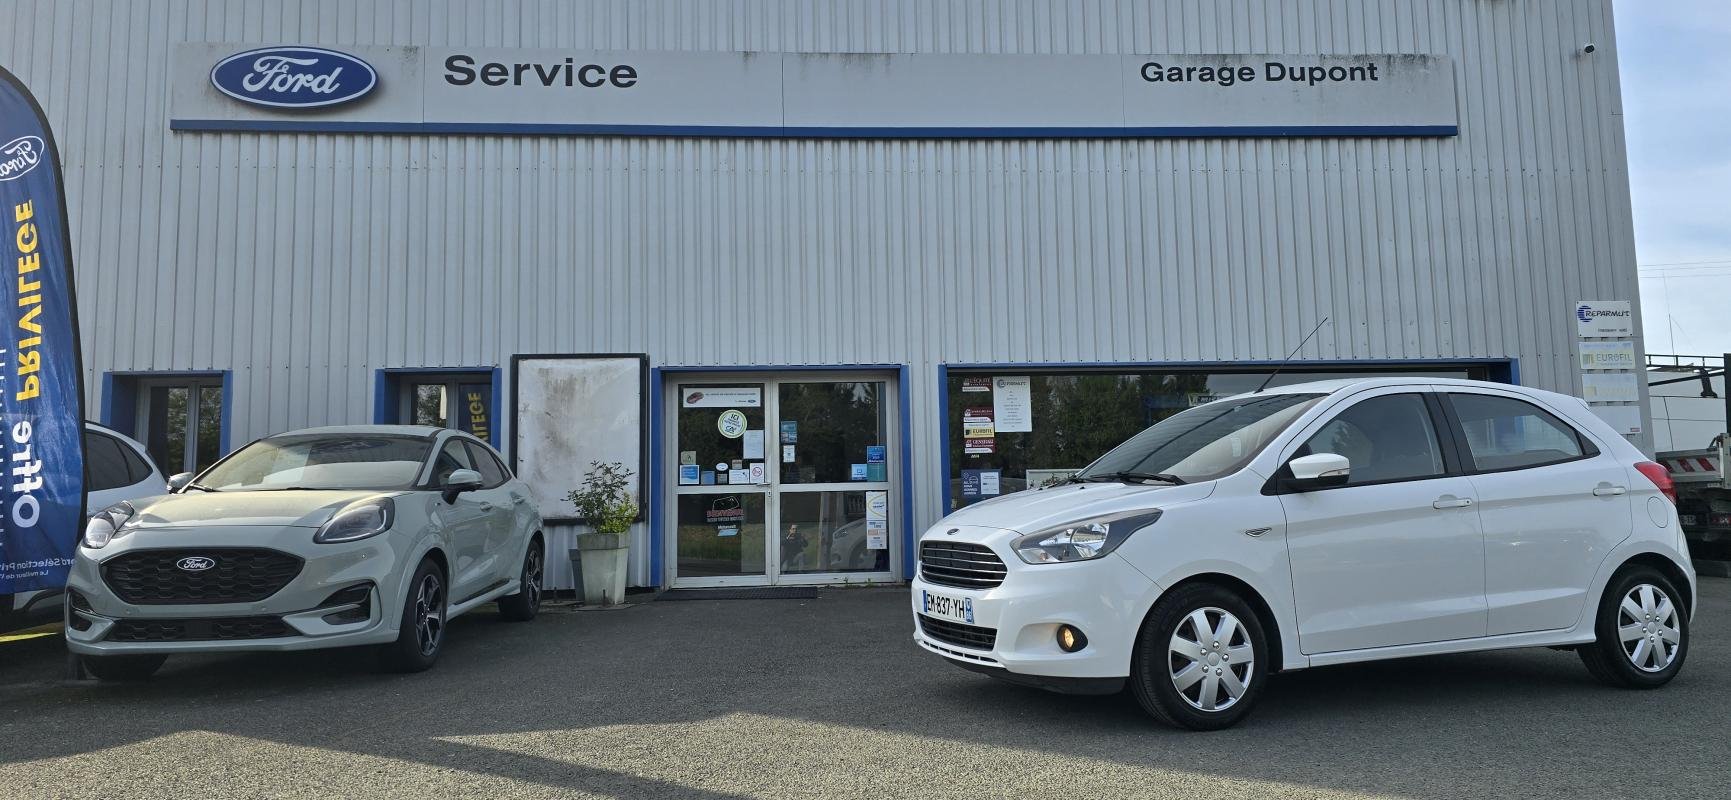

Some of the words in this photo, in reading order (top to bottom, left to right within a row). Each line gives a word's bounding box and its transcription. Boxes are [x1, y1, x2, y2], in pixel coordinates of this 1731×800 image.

[242, 56, 343, 95] Ford
[444, 54, 638, 89] Service
[1140, 62, 1256, 87] Garage
[1264, 62, 1379, 87] Dupont
[183, 558, 208, 569] Ford
